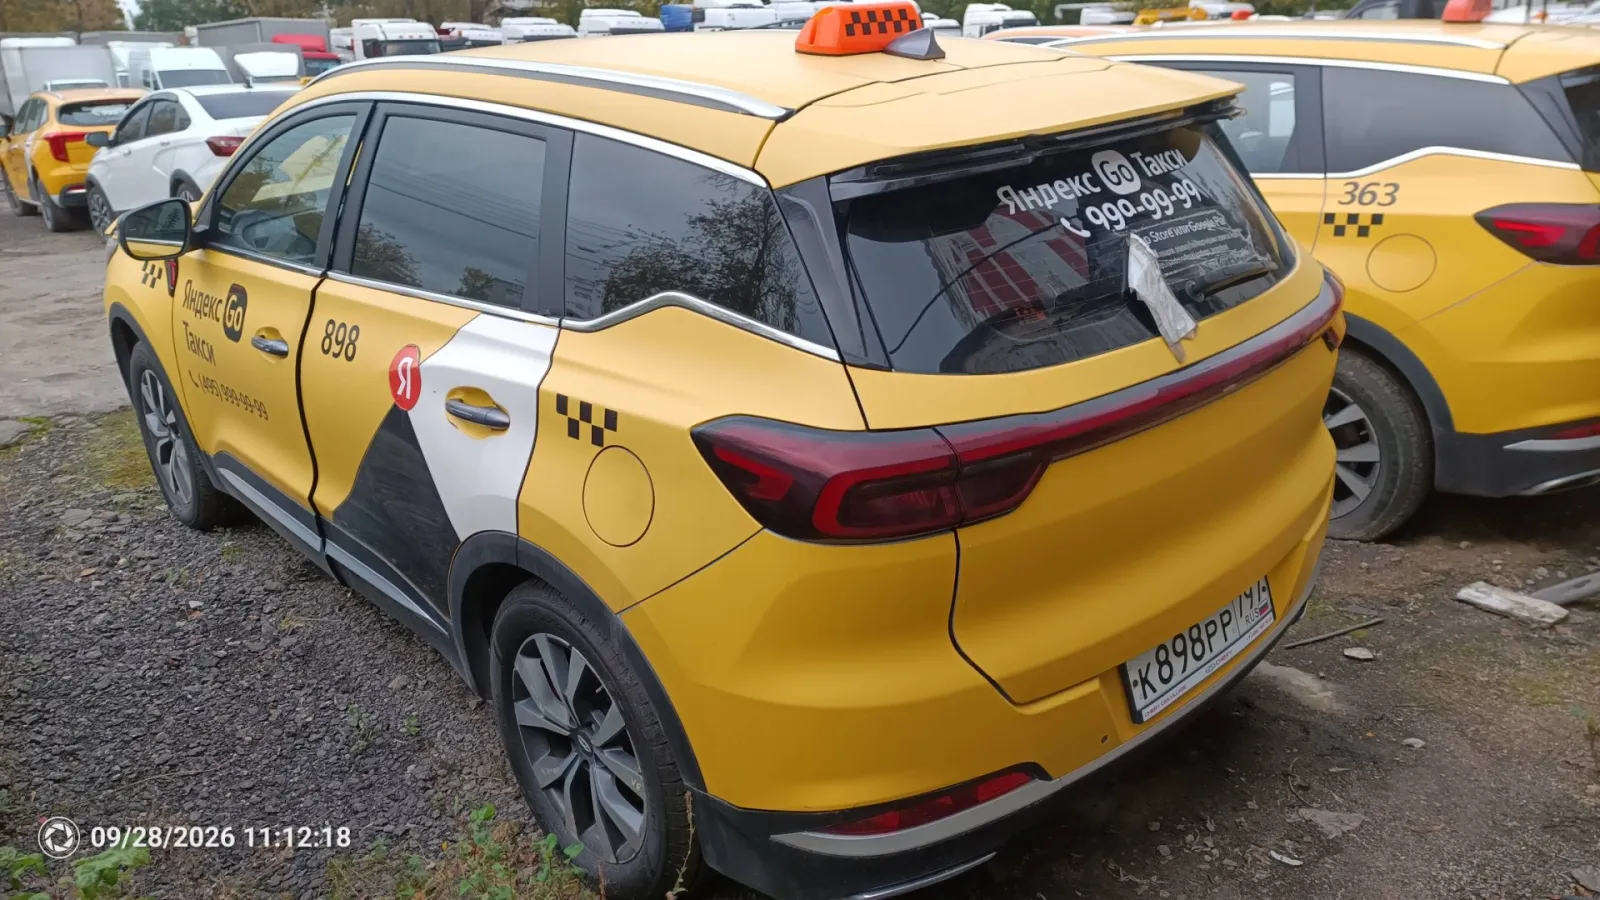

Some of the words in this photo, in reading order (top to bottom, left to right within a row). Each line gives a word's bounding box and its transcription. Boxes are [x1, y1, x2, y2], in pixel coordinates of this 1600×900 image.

[997, 172, 1102, 215] Яндекс
[1130, 148, 1190, 178] Такси
[1337, 181, 1400, 207] 363
[1149, 226, 1175, 243] Store
[182, 279, 223, 322] Яндекс
[182, 320, 216, 367] Такси
[321, 319, 360, 362] 898
[197, 372, 223, 402] (495)
[220, 384, 268, 421] 999-99-99
[397, 356, 413, 399] Я
[1245, 607, 1259, 625] RUS
